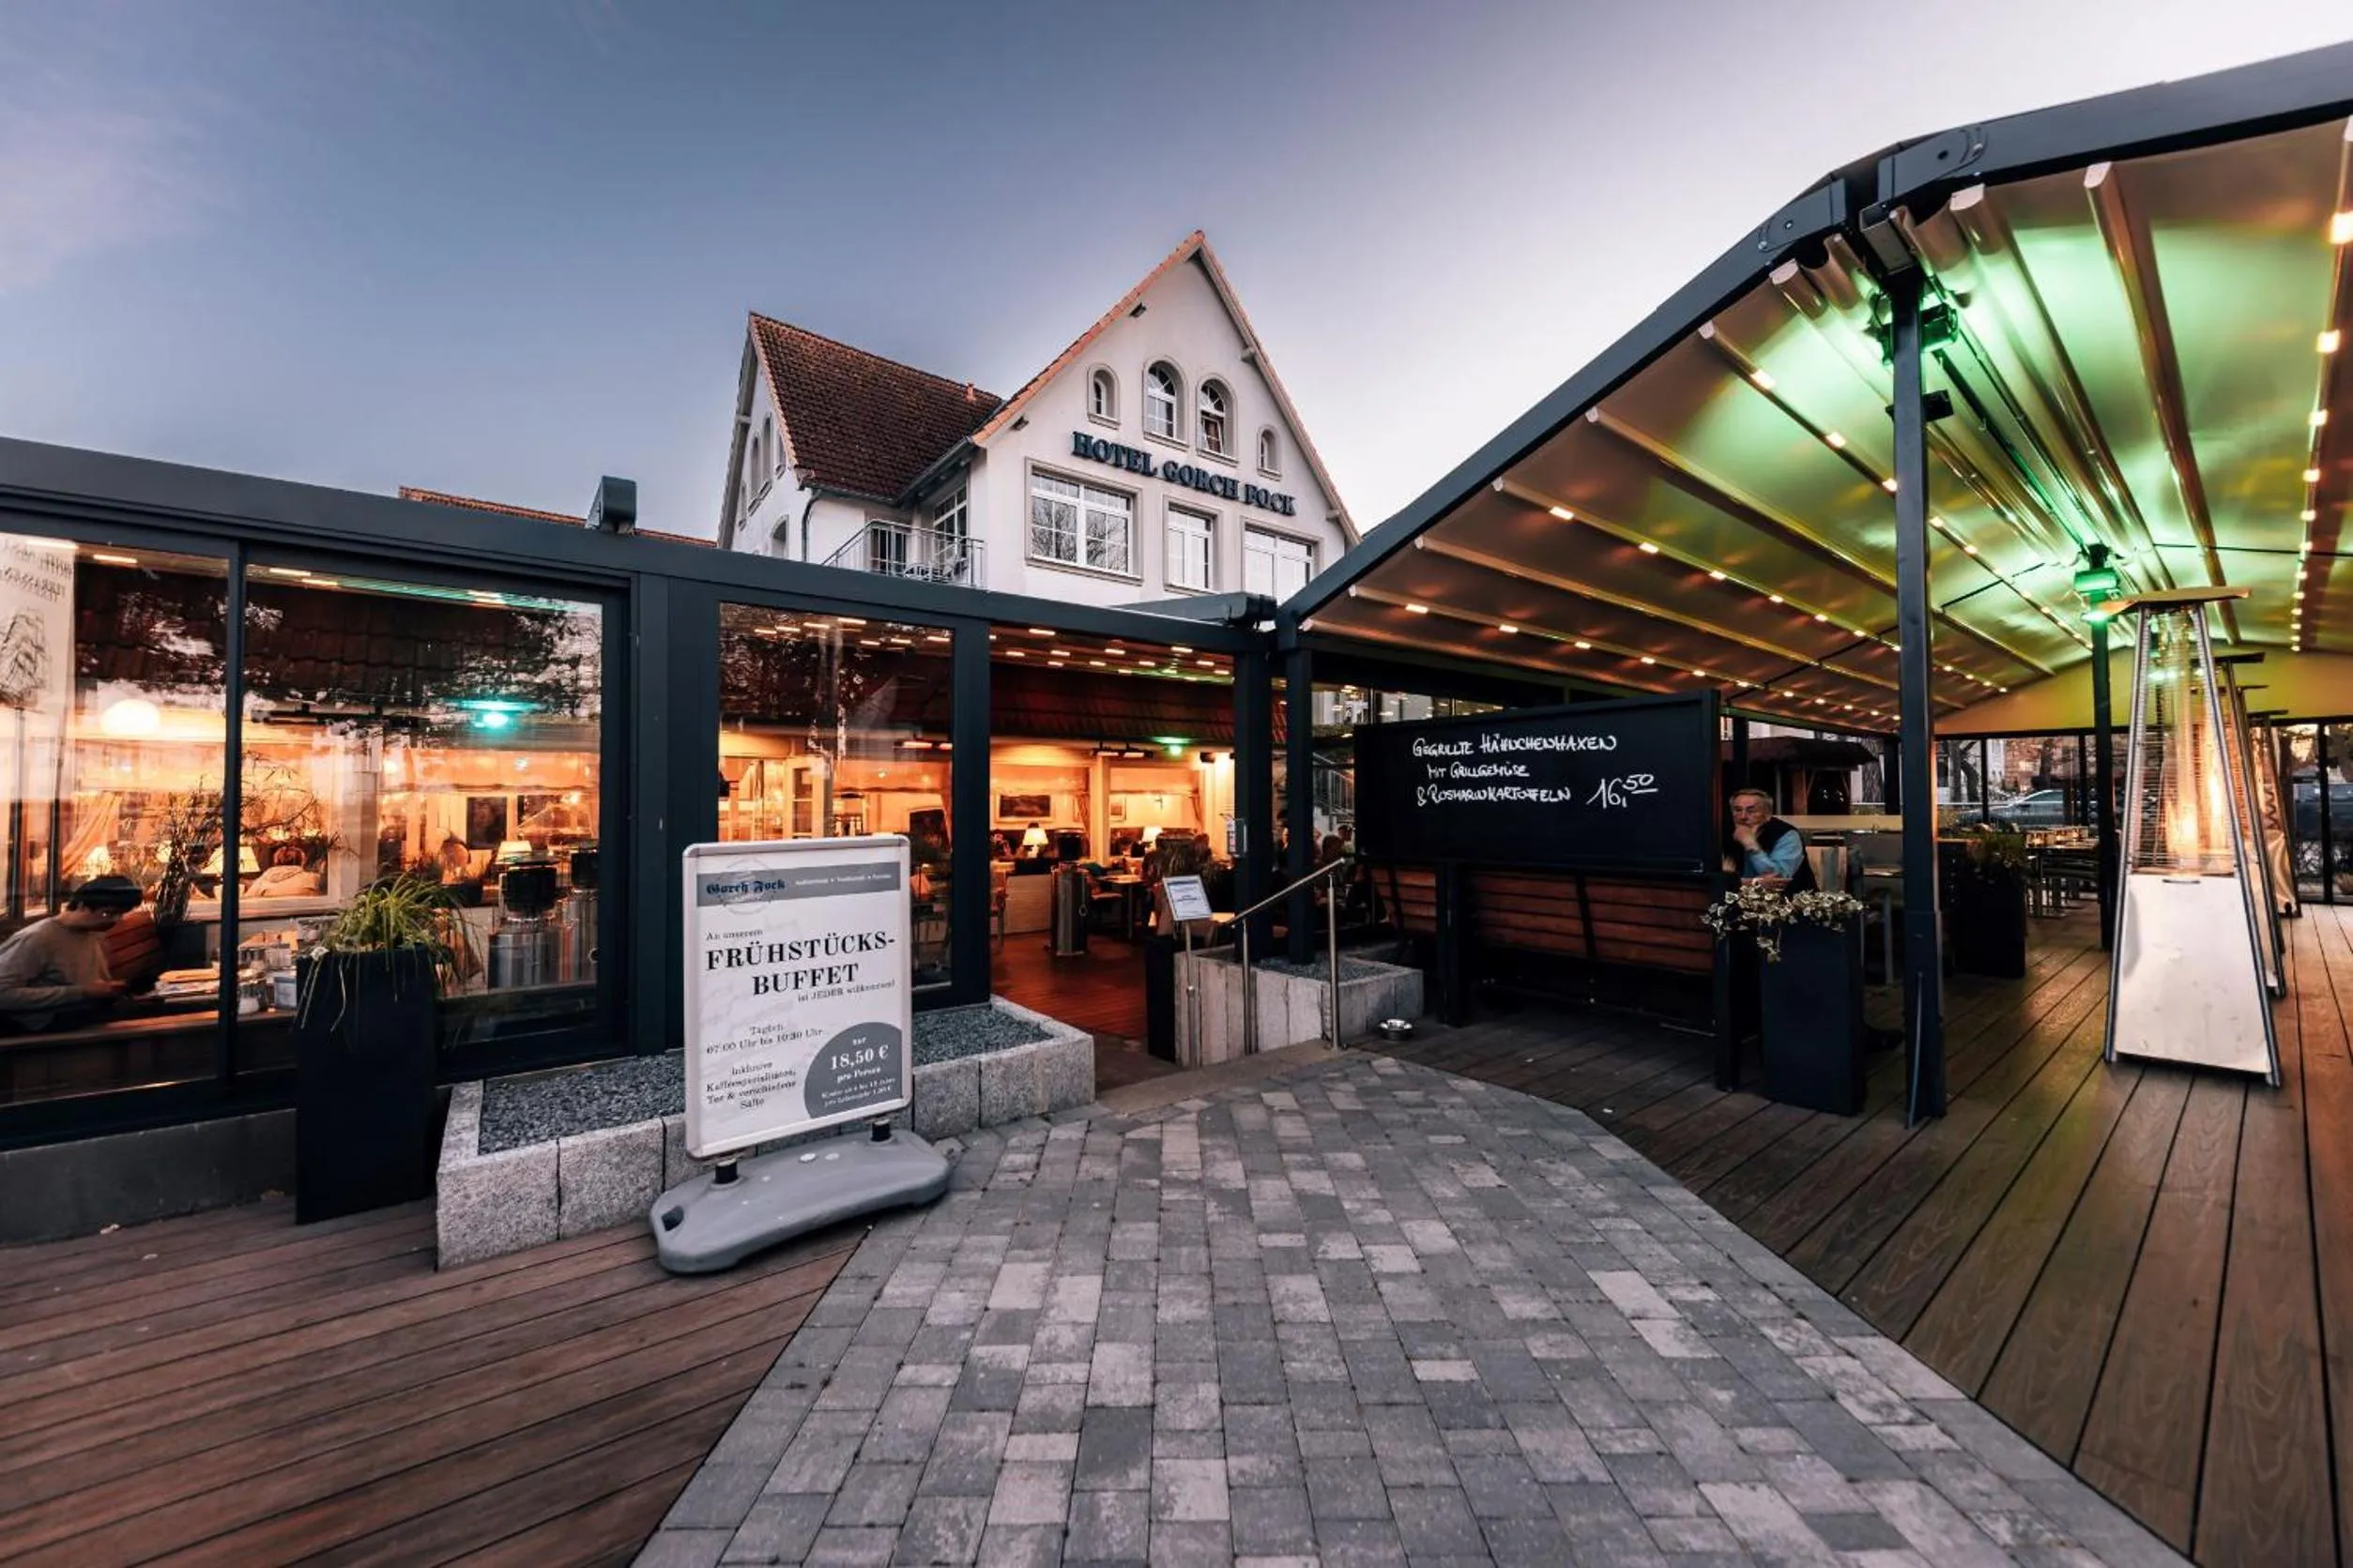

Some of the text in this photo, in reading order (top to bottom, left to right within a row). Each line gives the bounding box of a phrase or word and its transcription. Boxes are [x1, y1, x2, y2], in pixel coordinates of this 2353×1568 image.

[1070, 431, 1297, 516] HOTEL GORCH FOCK
[1427, 764, 1446, 780] MIT
[706, 879, 786, 895] Gorch Fock
[706, 931, 895, 970] FRÜHSTÜCKS-
[752, 963, 859, 996] BUFFET
[879, 1043, 889, 1060] €
